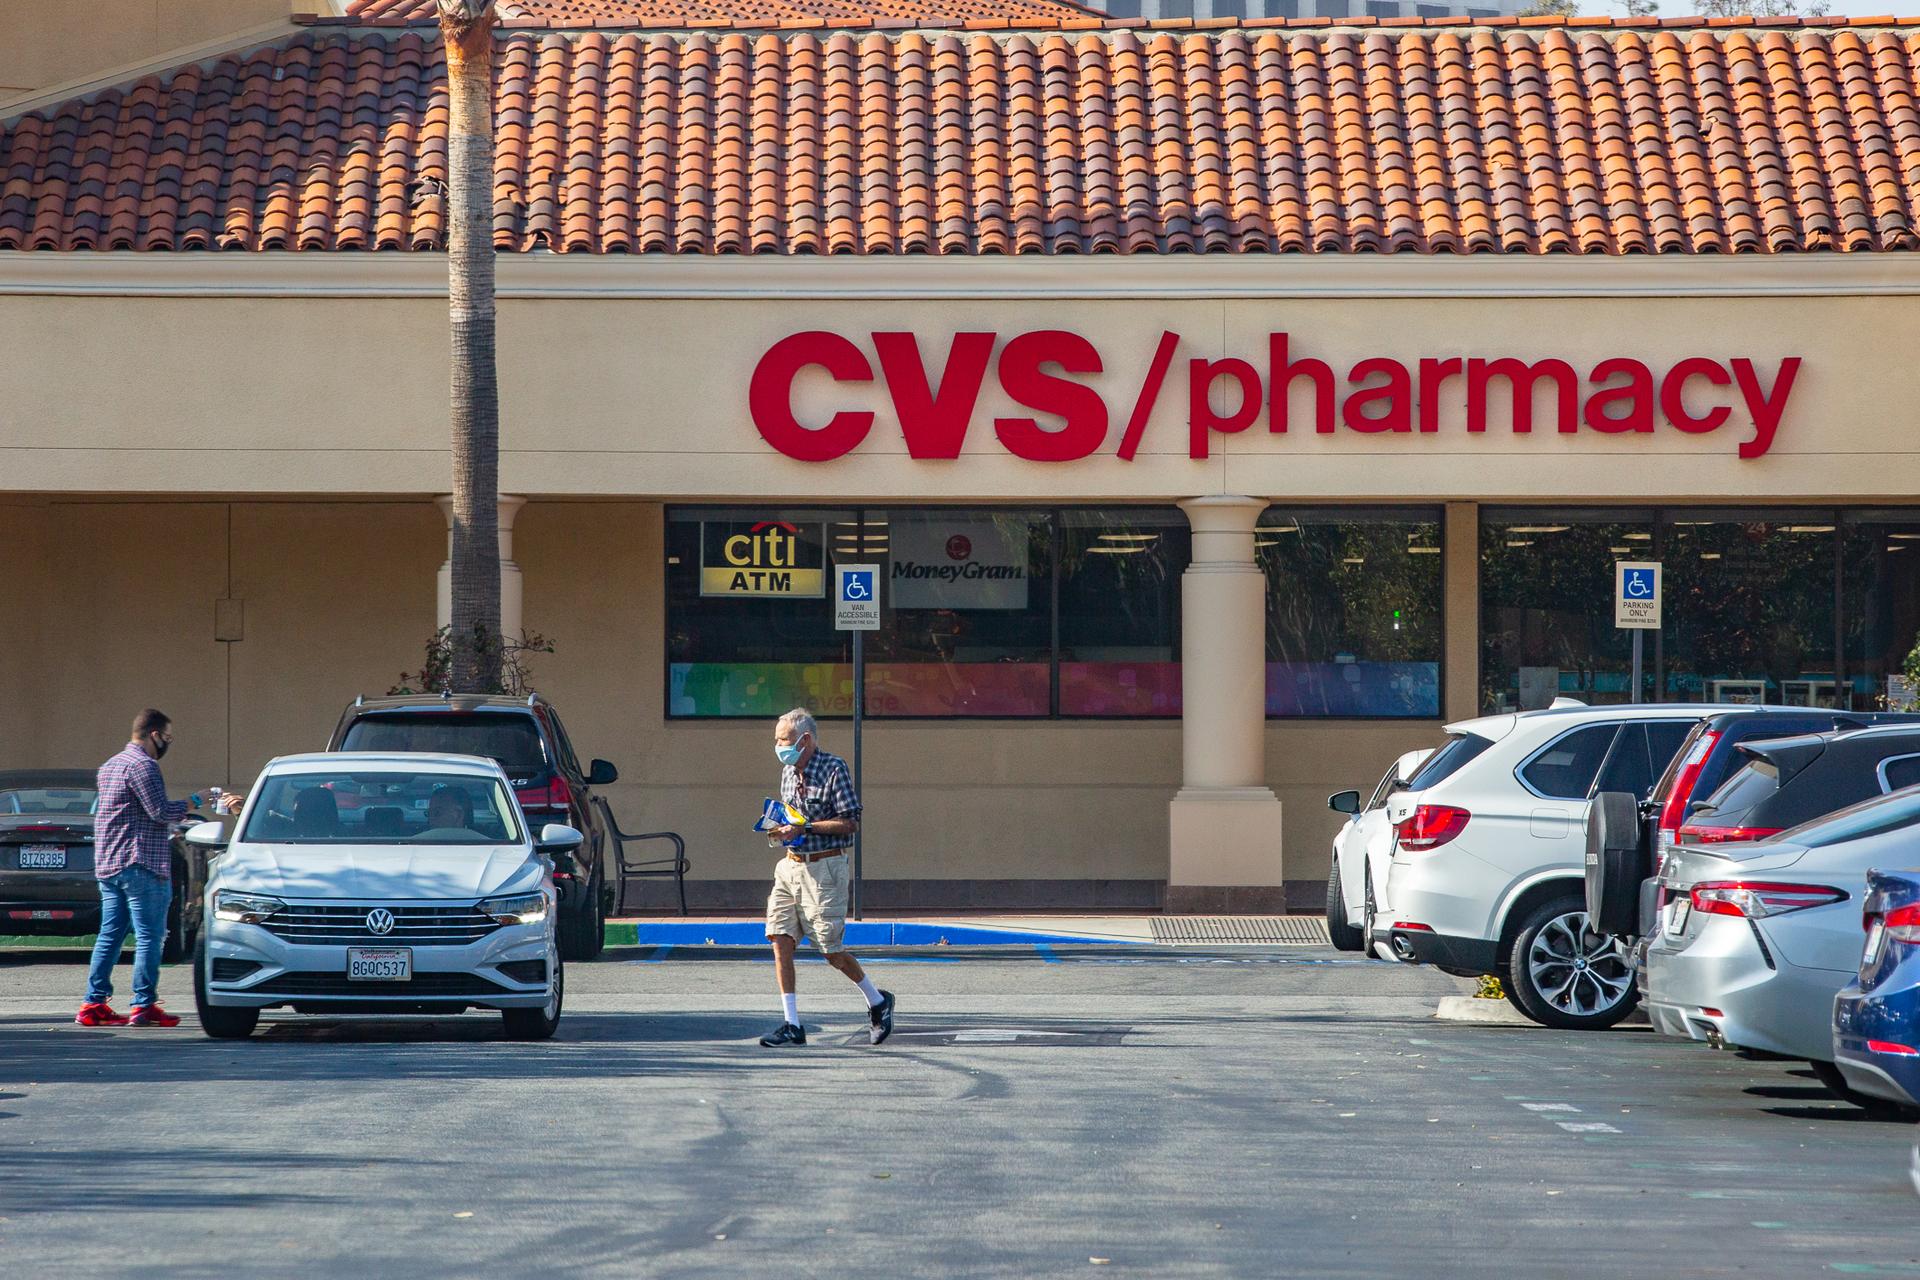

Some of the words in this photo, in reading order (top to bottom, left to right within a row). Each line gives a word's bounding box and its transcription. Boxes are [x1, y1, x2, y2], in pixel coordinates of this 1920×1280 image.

[724, 526, 796, 567] citi
[891, 560, 1023, 584] MoneyGram
[729, 571, 792, 592] ATM
[1623, 601, 1655, 609] PARKING
[837, 611, 879, 619] ACCESSIBLE
[1629, 609, 1649, 617] ONLY
[21, 853, 64, 865] 8TZR385
[352, 961, 406, 976] 8GQC537
